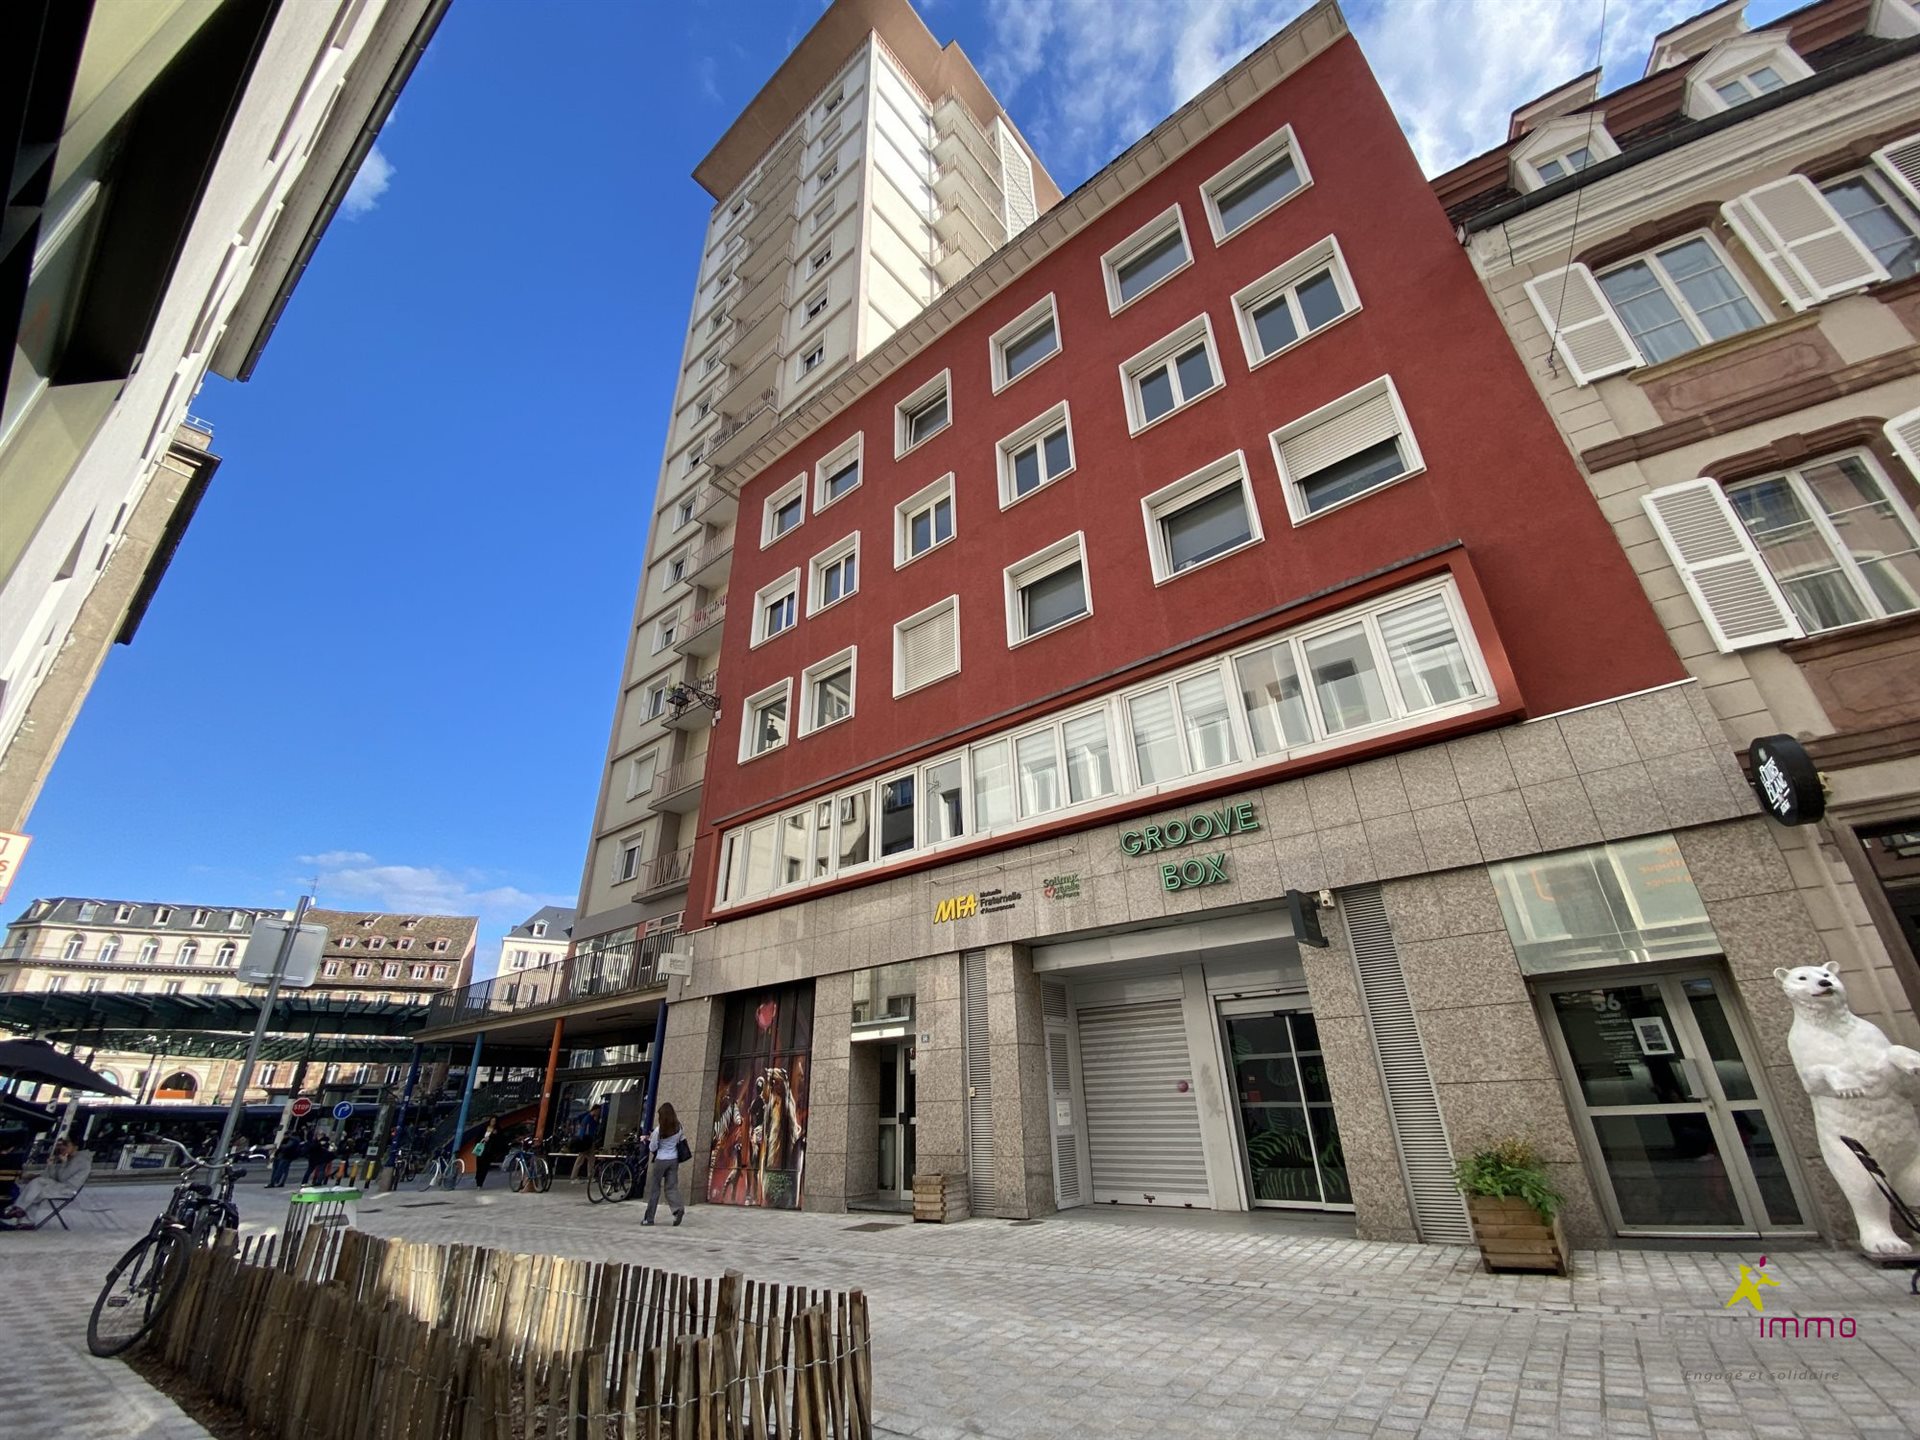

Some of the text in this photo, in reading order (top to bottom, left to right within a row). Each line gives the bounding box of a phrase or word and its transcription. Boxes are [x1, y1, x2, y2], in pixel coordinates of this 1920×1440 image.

[1121, 801, 1260, 856] GROOVE
[1161, 853, 1228, 891] BOX
[933, 890, 978, 925] MFA
[980, 892, 1022, 907] Fraternelle
[293, 1103, 310, 1111] STOP
